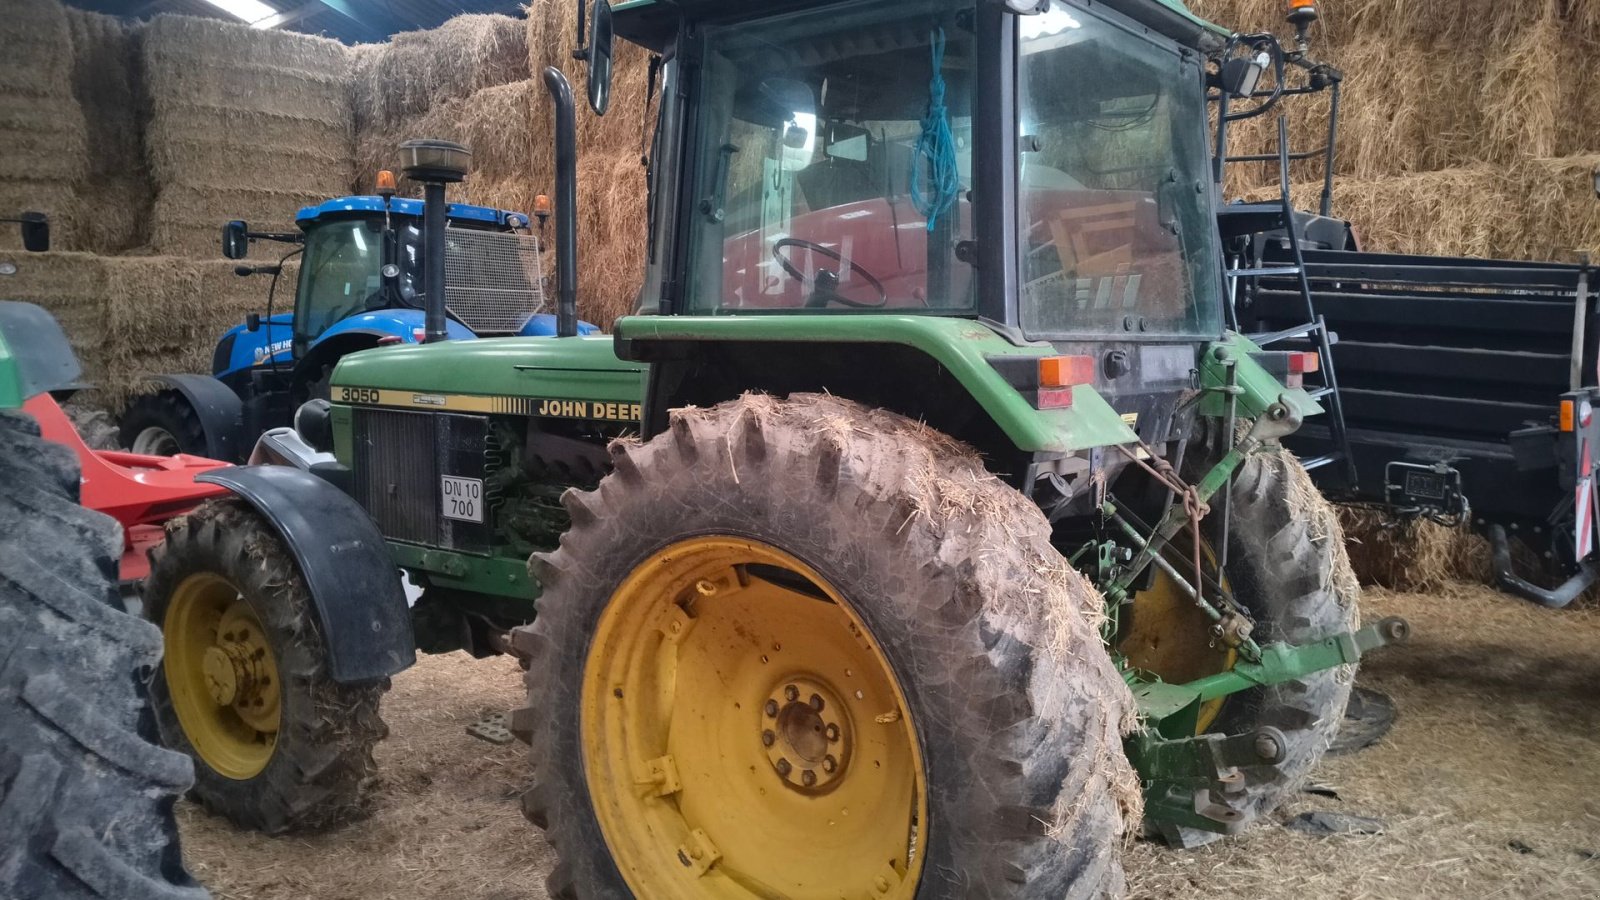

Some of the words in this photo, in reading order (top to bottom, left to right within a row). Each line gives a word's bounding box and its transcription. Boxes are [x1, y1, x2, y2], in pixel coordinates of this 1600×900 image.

[264, 341, 282, 355] NEW
[342, 388, 380, 403] 3050
[539, 399, 587, 418] JOHN
[444, 480, 461, 496] DN
[465, 483, 479, 499] 10
[450, 499, 474, 517] 700
